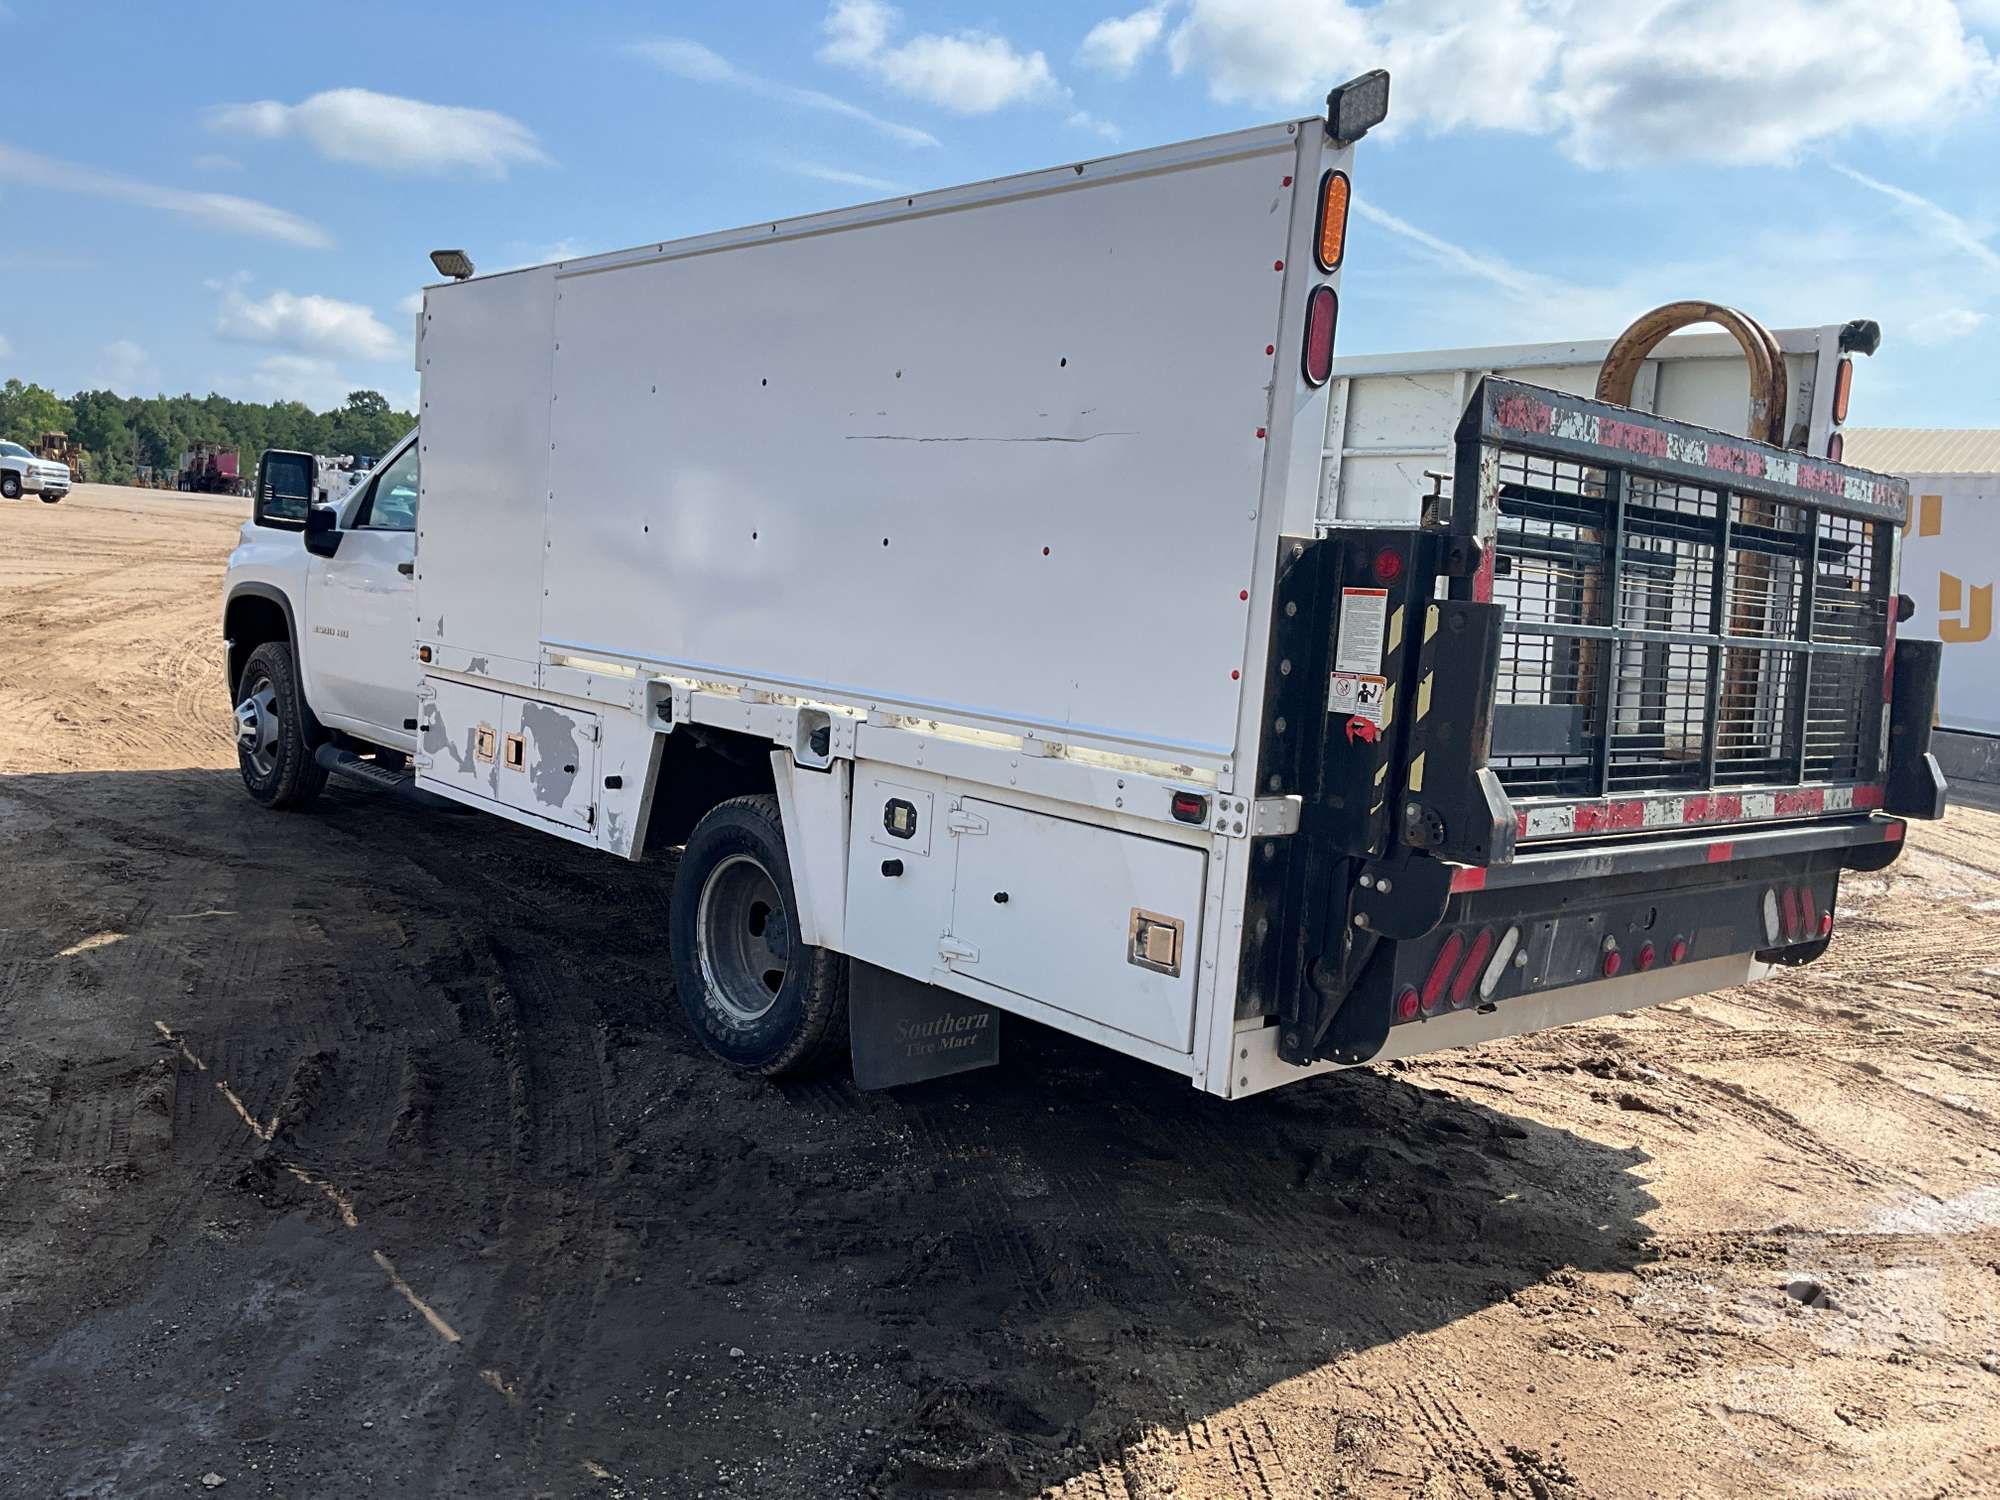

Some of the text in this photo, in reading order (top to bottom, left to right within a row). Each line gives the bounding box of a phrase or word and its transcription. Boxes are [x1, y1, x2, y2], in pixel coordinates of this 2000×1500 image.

[896, 1013, 989, 1041] Southern
[906, 1034, 977, 1057] Tire Mart
